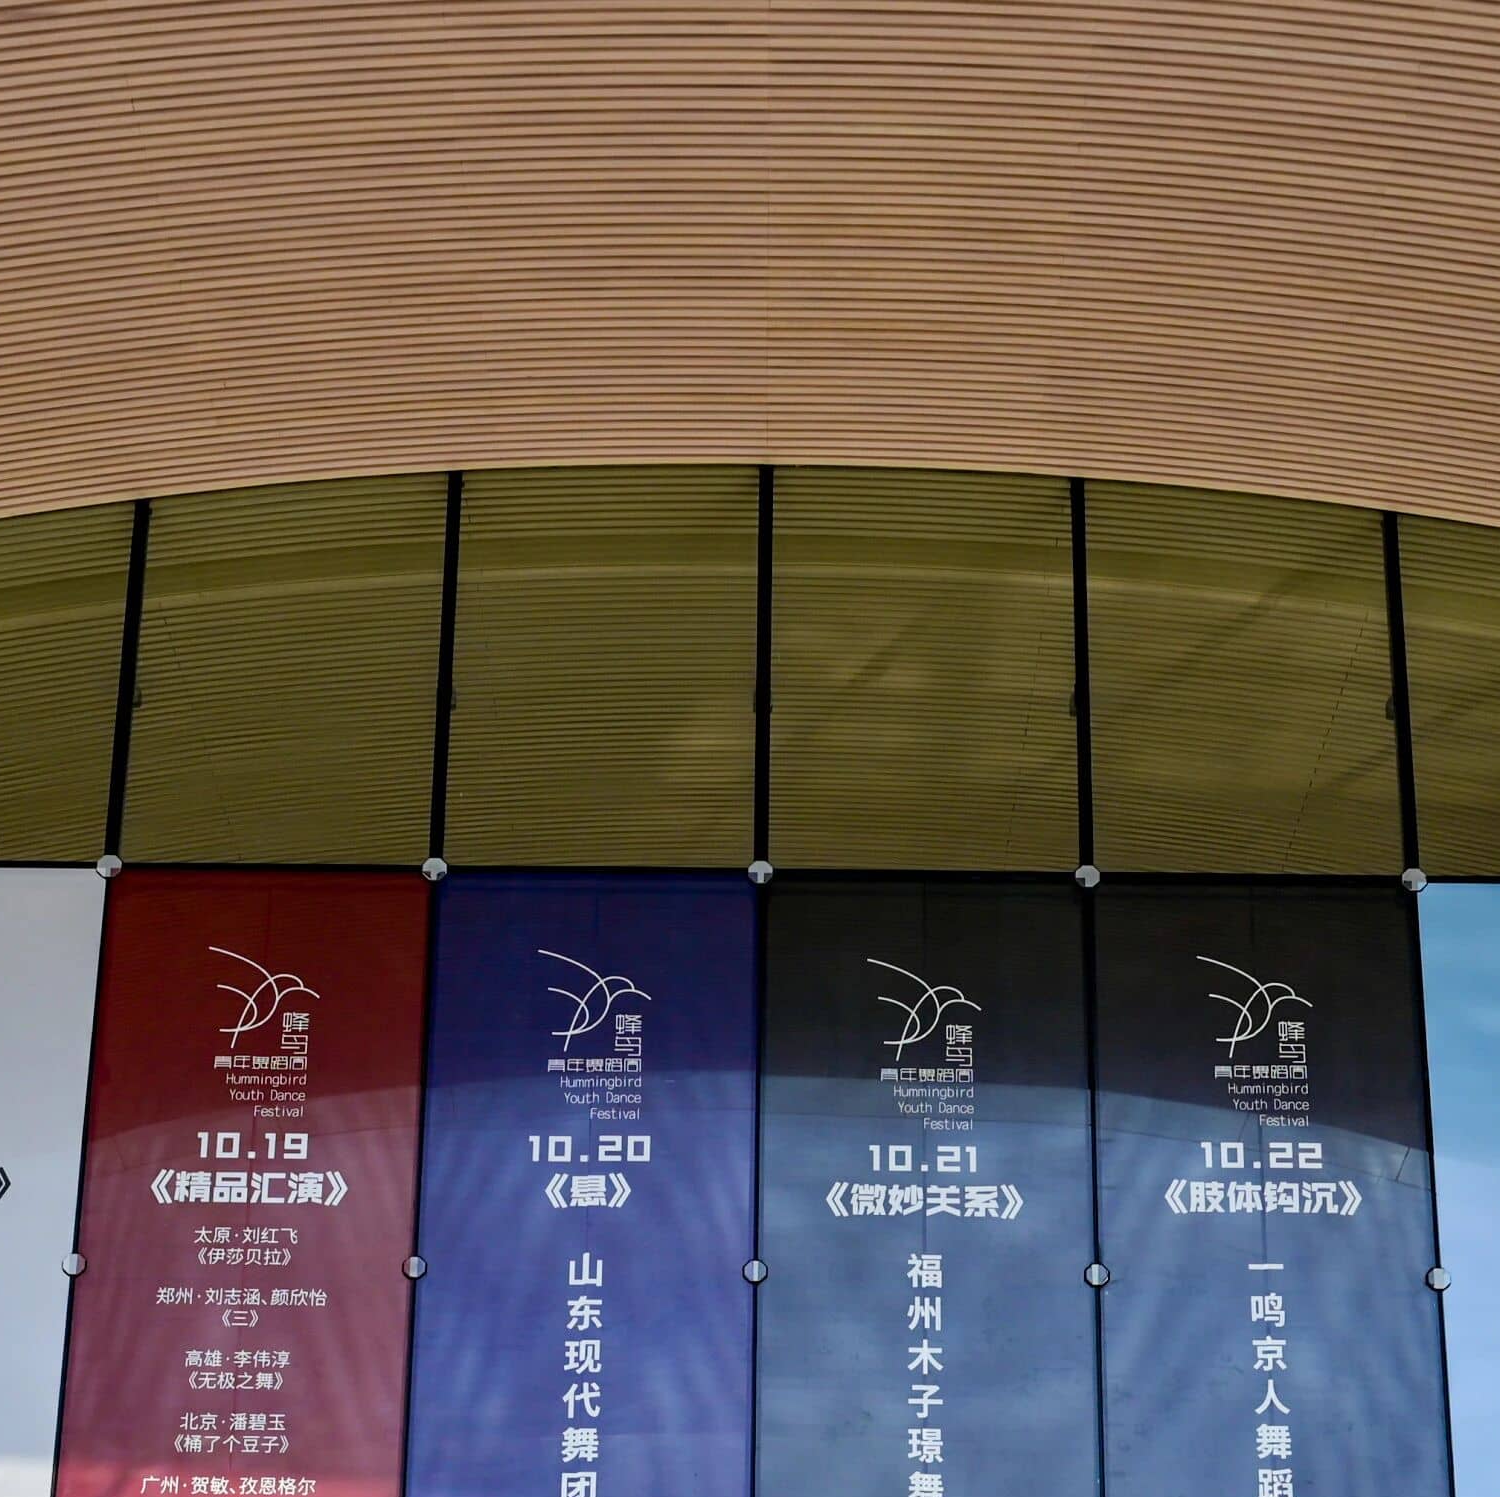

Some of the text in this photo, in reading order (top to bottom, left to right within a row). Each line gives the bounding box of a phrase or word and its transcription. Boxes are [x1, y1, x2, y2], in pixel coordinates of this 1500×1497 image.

[281, 1012, 309, 1054] 蜂鸟
[614, 1014, 642, 1056] 蜂鸟
[945, 1025, 974, 1067] 蜂鸟
[1277, 1022, 1306, 1063] 蜂鸟
[225, 1073, 307, 1087] Hummingbird
[561, 1076, 642, 1090] Hummingbird
[229, 1088, 305, 1101] Youth Dance
[564, 1092, 641, 1104] Youth Dance
[893, 1085, 974, 1100] Hummingbird
[1227, 1082, 1309, 1097] Hummingbird
[253, 1104, 304, 1118] Festival
[898, 1102, 974, 1114] Youth Dance
[1232, 1099, 1309, 1111] Youth Dance
[591, 1108, 640, 1120] Festival
[1259, 1114, 1309, 1127] Festival
[923, 1118, 974, 1130] Festival
[196, 1132, 309, 1159] 10.19
[528, 1135, 651, 1163] 10.20
[867, 1145, 977, 1173] 10.21
[1200, 1142, 1323, 1170] 10.22
[149, 1170, 349, 1206] 《精品汇演》
[825, 1183, 1025, 1220] 《微妙关系》
[1163, 1180, 1363, 1216] 《肢体钩沉》
[196, 1248, 292, 1266] 《伊莎贝拉》
[220, 1310, 259, 1327] 《三》
[186, 1371, 284, 1390] 《无极之舞》
